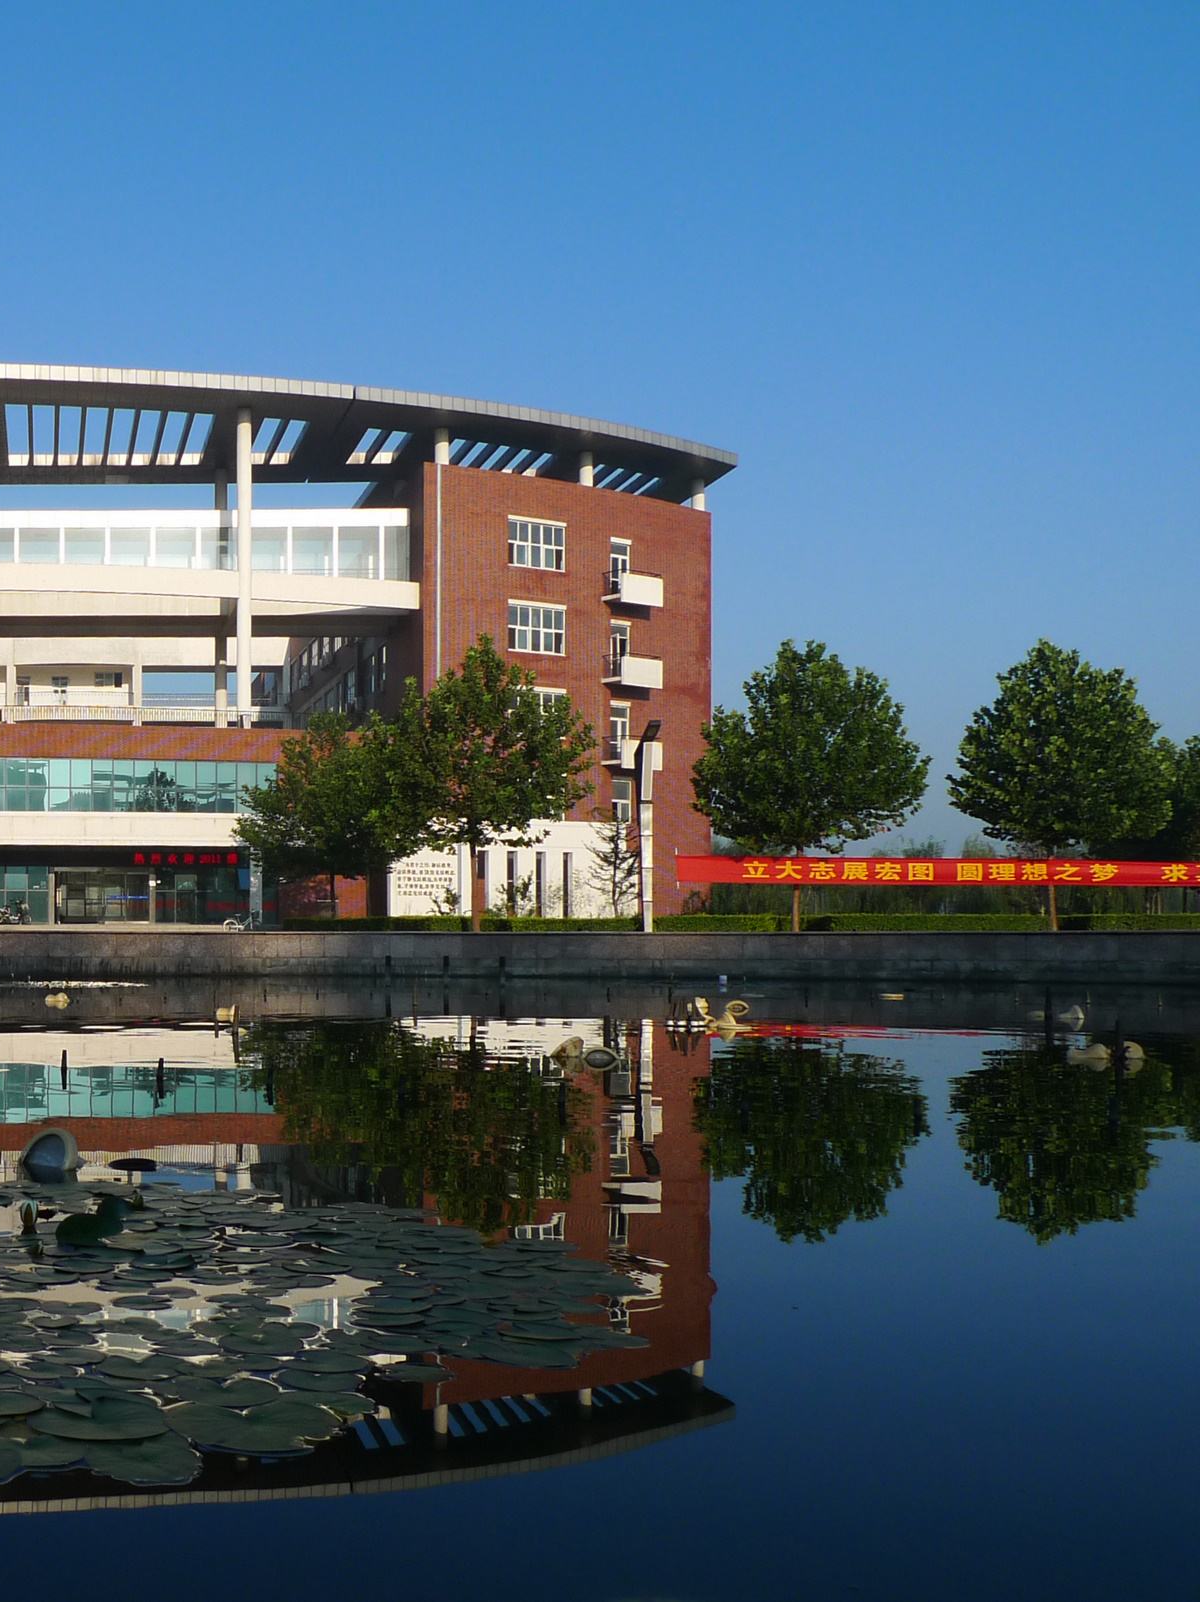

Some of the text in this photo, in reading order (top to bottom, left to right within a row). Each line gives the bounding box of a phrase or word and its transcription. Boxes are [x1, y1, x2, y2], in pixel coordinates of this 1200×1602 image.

[742, 861, 1200, 882] 立大志展宏图 圆理想之梦 求
